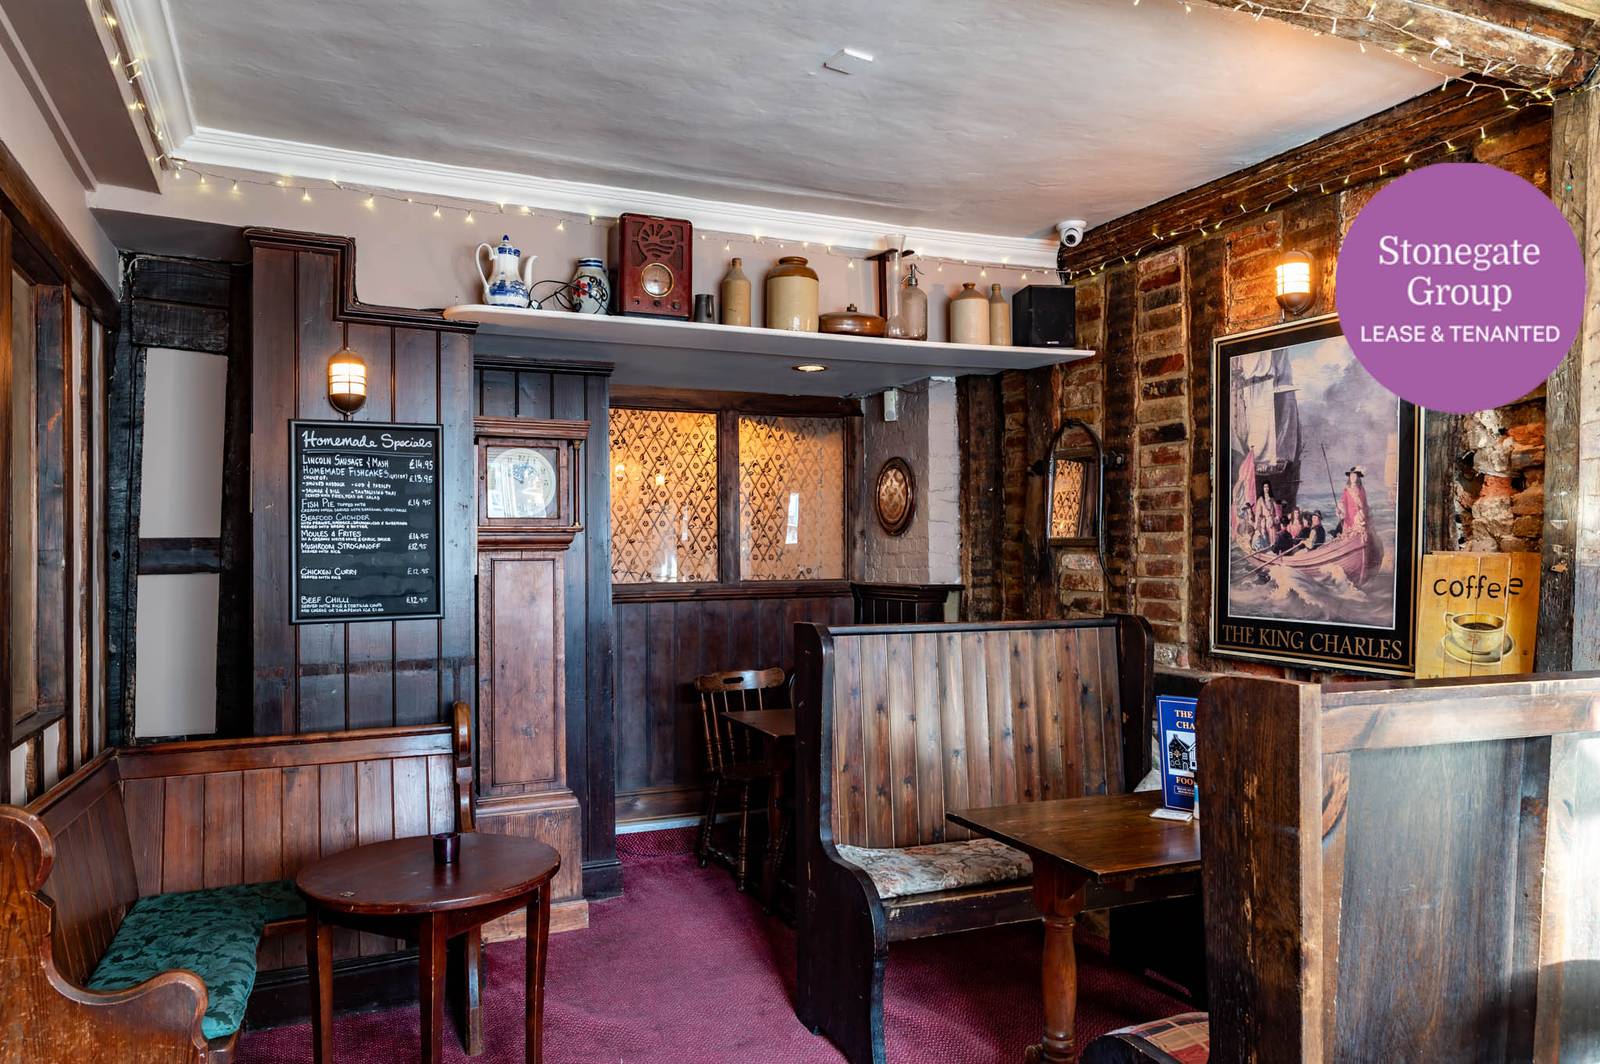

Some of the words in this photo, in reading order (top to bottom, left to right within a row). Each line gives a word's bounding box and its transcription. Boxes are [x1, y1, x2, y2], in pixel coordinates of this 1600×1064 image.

[302, 430, 378, 448] Homemade
[380, 434, 432, 450] Specials
[409, 459, 433, 470] £14.95
[302, 467, 345, 476] HOMEMADE
[349, 467, 389, 478] FISHCAKES
[409, 475, 433, 484] £13.95
[302, 499, 319, 509] FISH
[322, 498, 335, 508] PIE
[334, 567, 357, 576] CURRY
[1434, 575, 1524, 599] coffee
[301, 596, 321, 604] BEEF
[1222, 624, 1254, 644] THE
[1259, 628, 1304, 650] KING
[1310, 632, 1402, 660] CHARLES
[1174, 710, 1194, 718] THE
